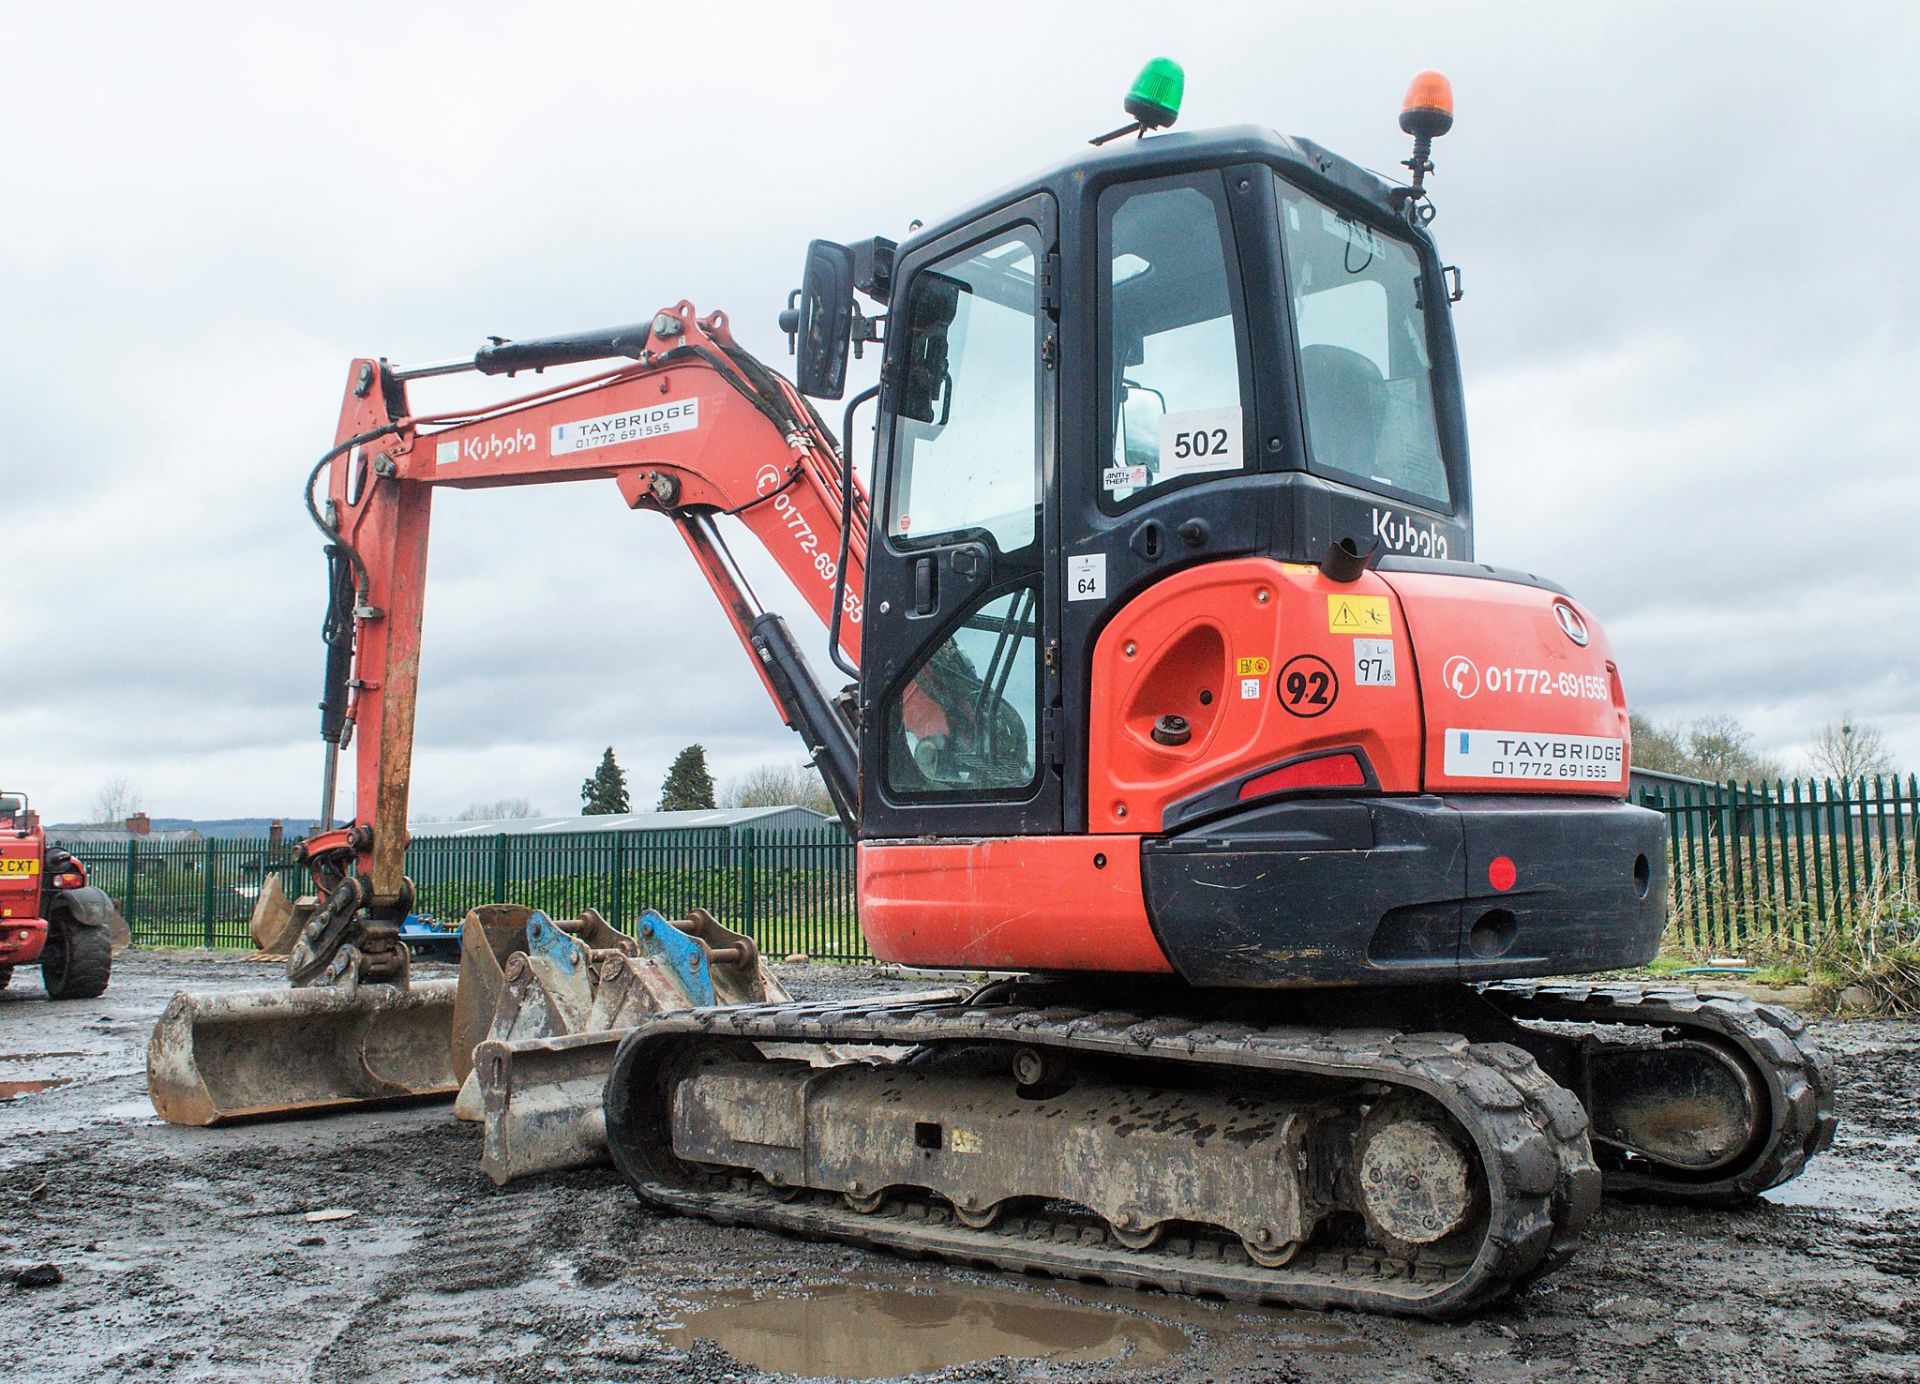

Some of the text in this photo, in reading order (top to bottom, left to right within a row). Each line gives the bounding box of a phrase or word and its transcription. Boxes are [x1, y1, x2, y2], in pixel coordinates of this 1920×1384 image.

[579, 403, 695, 436] TAYBRIDGE
[463, 428, 536, 461] Kubota
[576, 422, 670, 449] 01772 691555
[1174, 428, 1228, 459] 502
[1105, 477, 1129, 485] THEFT
[1372, 508, 1448, 560] Kubota
[1077, 577, 1096, 594] 64
[1358, 658, 1383, 682] 97
[1486, 665, 1608, 701] 01772-691555
[1497, 740, 1622, 762] TAYBRIDGE
[1492, 761, 1607, 778] 01772 691555
[7, 860, 33, 872] CXT
